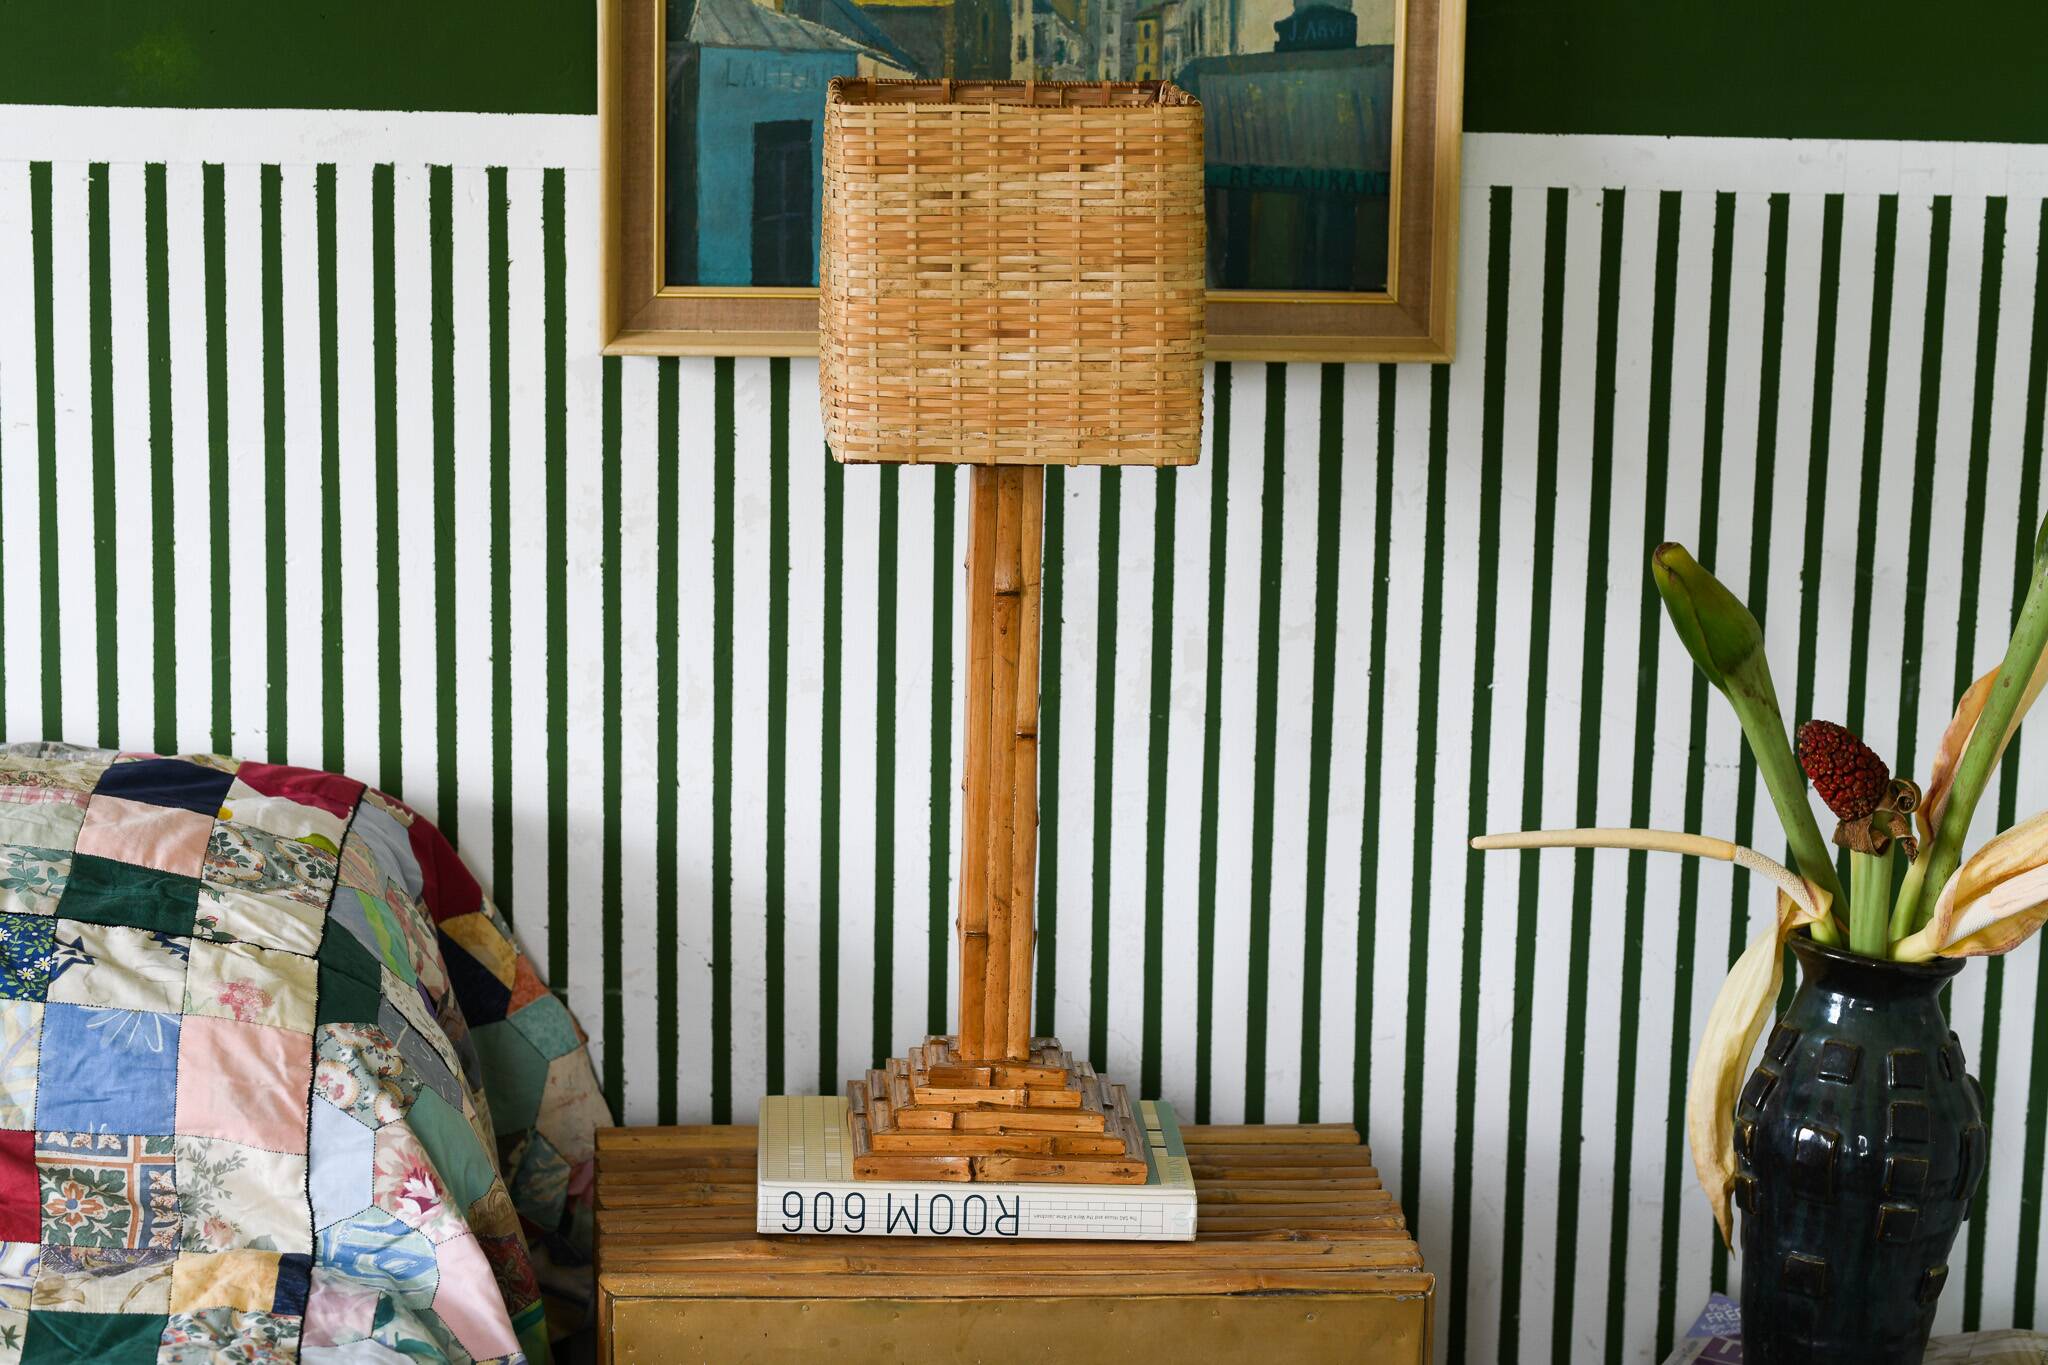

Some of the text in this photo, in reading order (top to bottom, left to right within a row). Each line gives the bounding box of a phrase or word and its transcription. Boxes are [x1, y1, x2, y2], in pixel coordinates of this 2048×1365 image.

[1229, 164, 1389, 194] RESTAURANT
[782, 1190, 1020, 1236] ROOM 606
